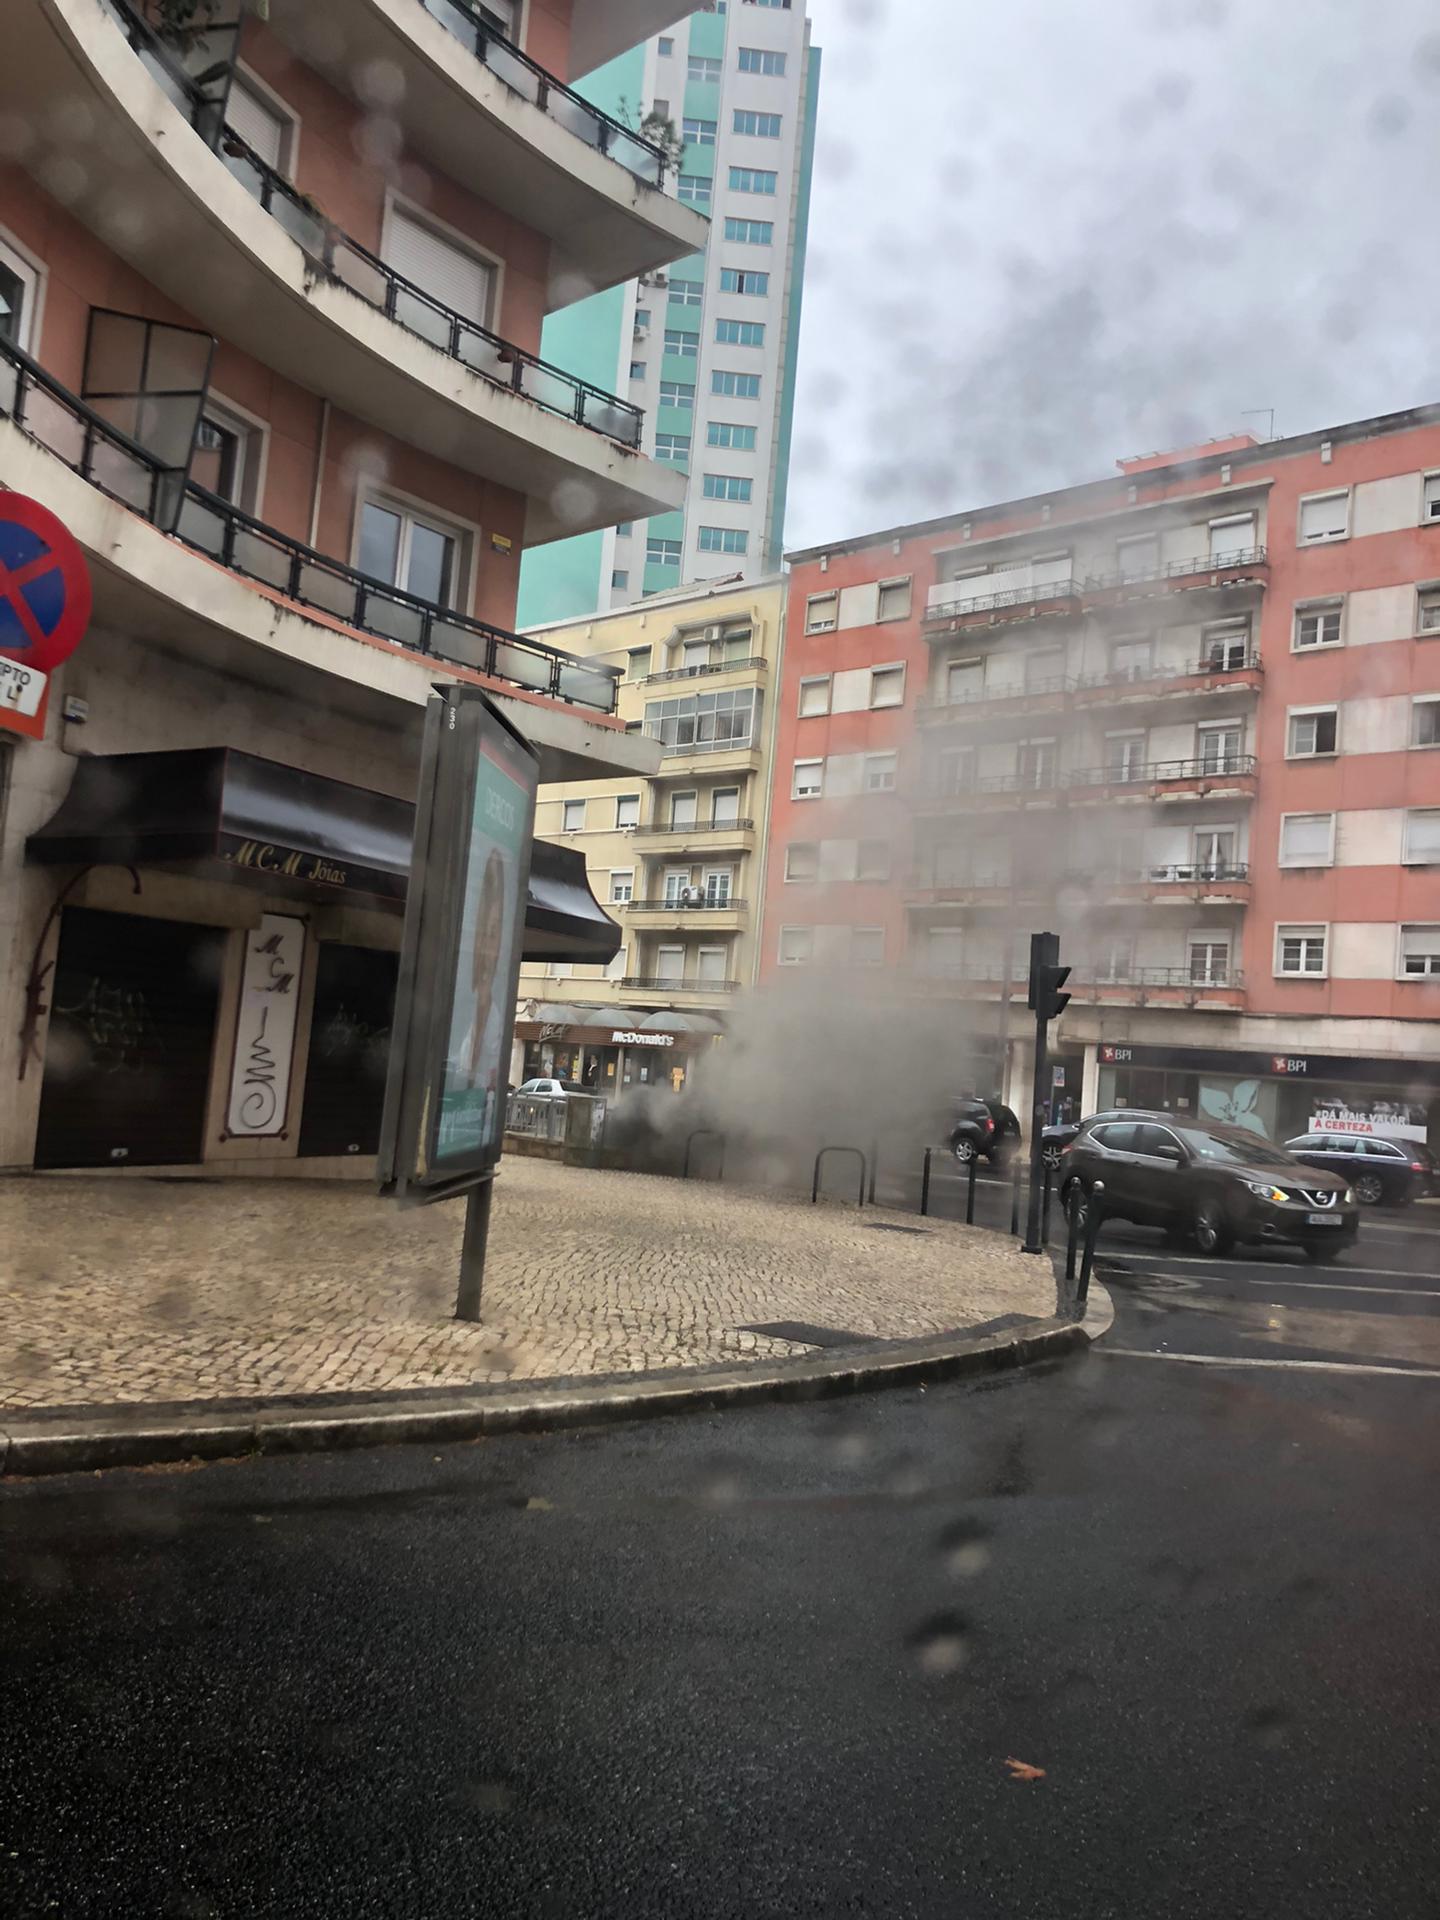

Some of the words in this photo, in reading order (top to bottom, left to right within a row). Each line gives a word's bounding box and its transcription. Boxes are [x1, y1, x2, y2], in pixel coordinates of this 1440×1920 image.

[611, 1031, 674, 1046] McDonald's
[1115, 1048, 1132, 1060] BPI
[1287, 1059, 1307, 1073] BPI
[1339, 1111, 1367, 1122] MAIS
[1325, 1120, 1373, 1133] CERTEZA
